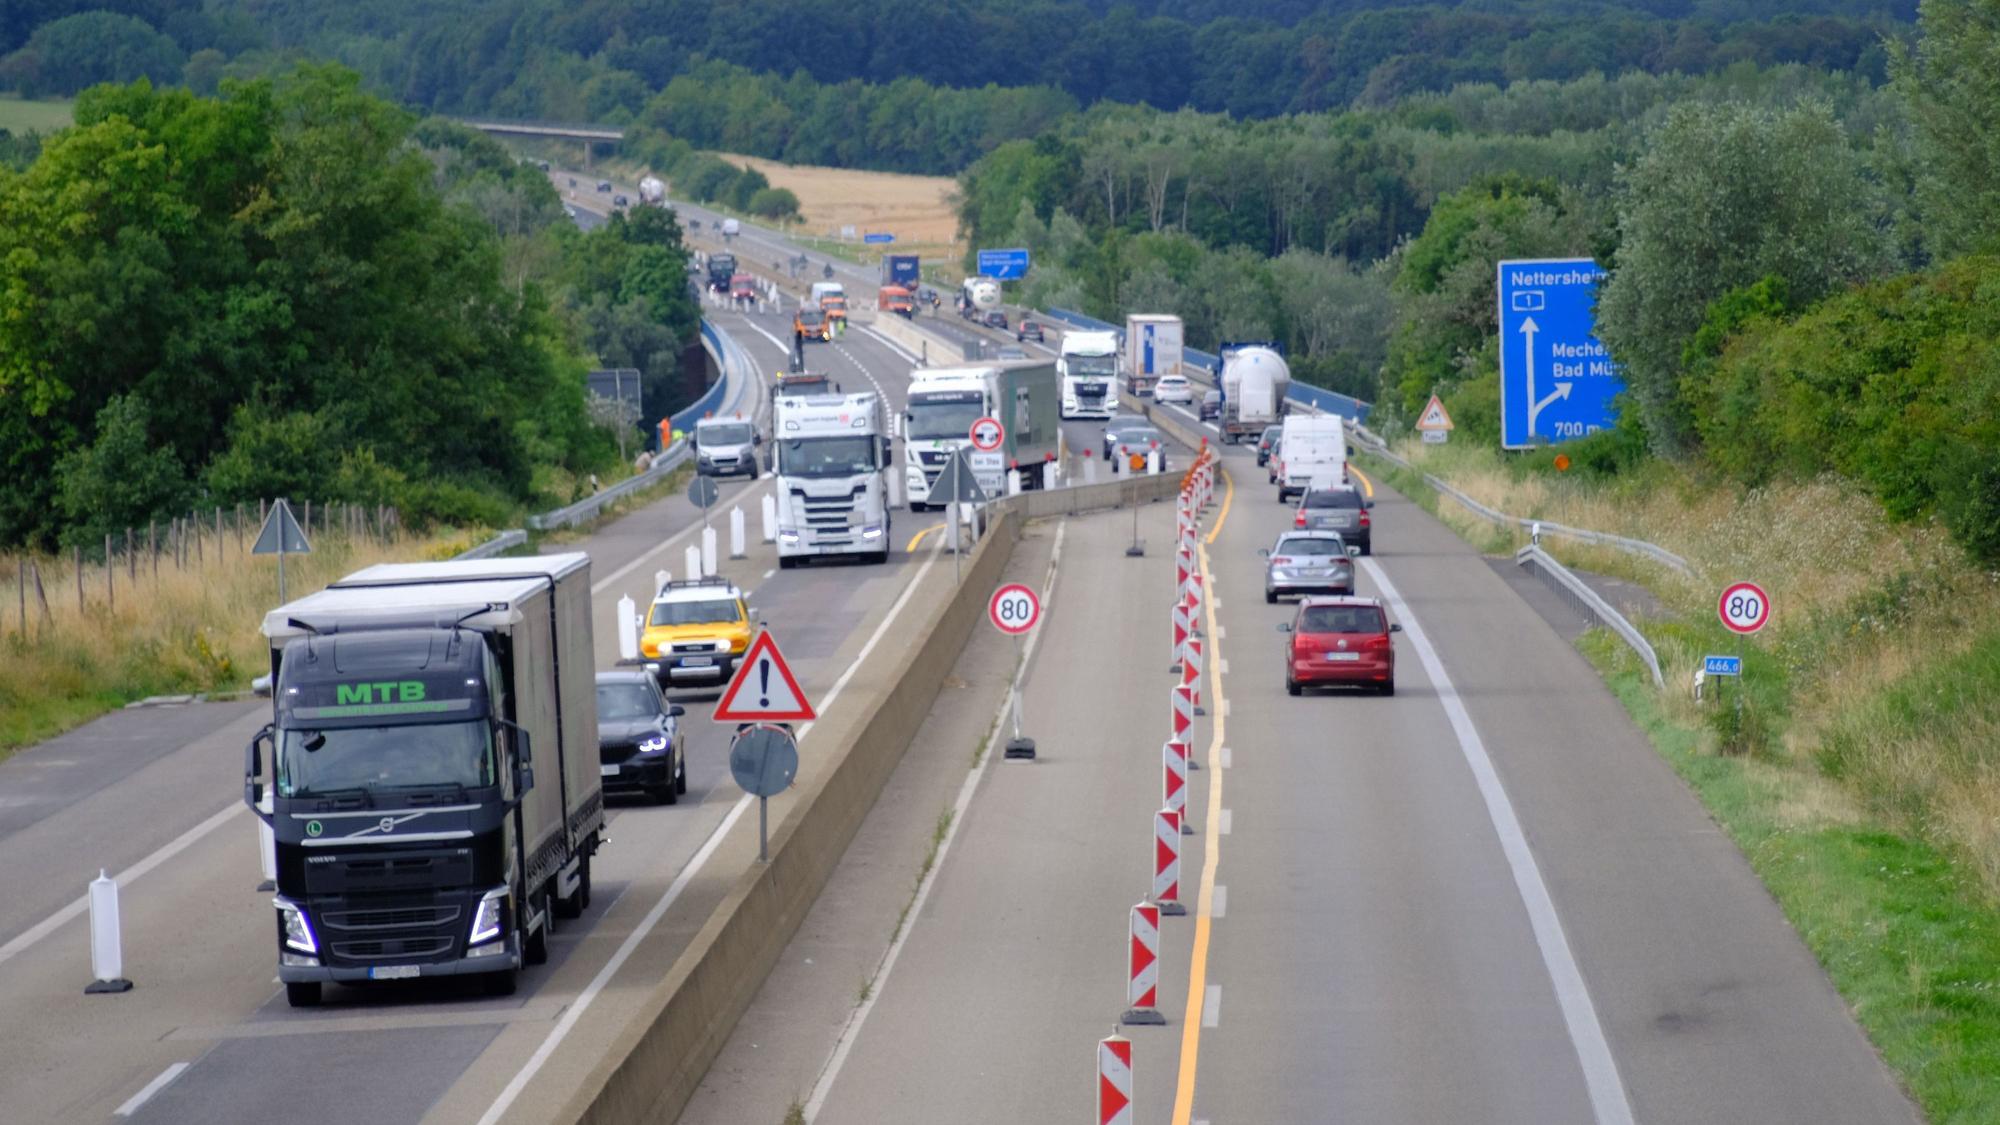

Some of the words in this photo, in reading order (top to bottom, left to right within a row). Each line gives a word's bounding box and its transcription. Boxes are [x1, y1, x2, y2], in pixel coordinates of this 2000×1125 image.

[1552, 342, 1609, 358] Meche
[1553, 363, 1583, 378] Bad
[1554, 422, 1583, 437] 700
[1001, 599, 1028, 620] 80
[1730, 597, 1758, 619] 80
[336, 681, 426, 705] MTB
